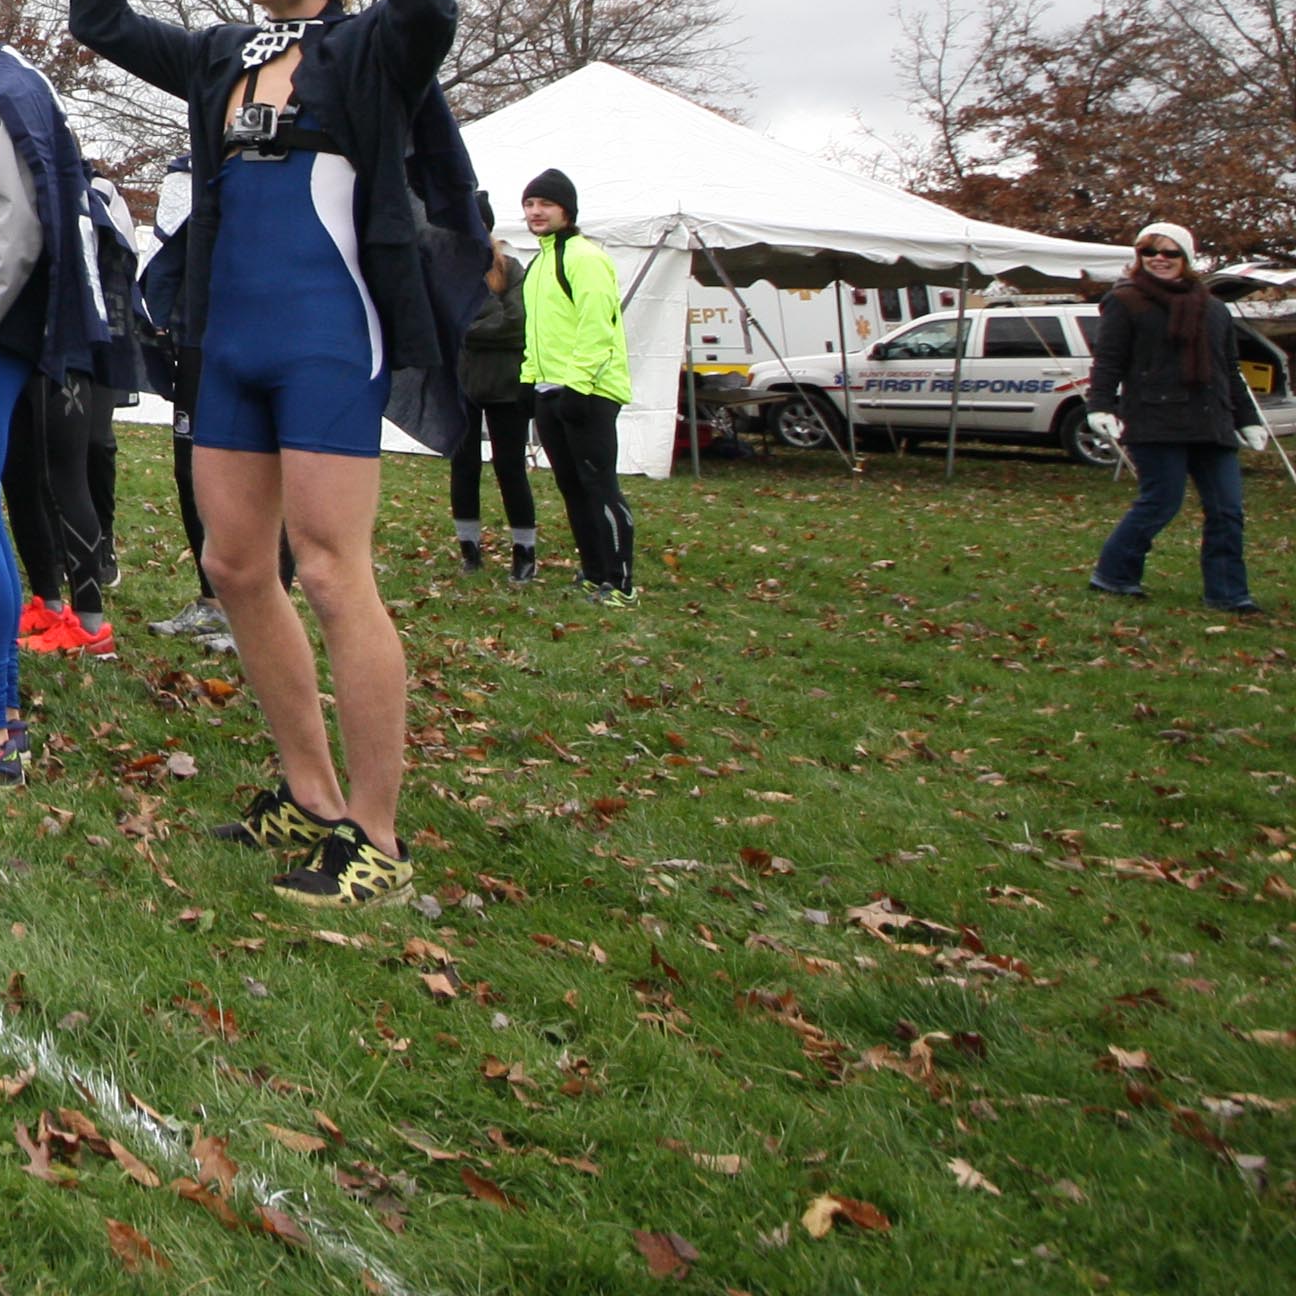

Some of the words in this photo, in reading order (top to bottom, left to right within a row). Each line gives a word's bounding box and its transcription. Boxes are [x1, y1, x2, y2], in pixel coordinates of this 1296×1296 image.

[689, 307, 734, 325] EPT.
[863, 378, 926, 393] FIRST
[929, 378, 1056, 394] RESPONSE
